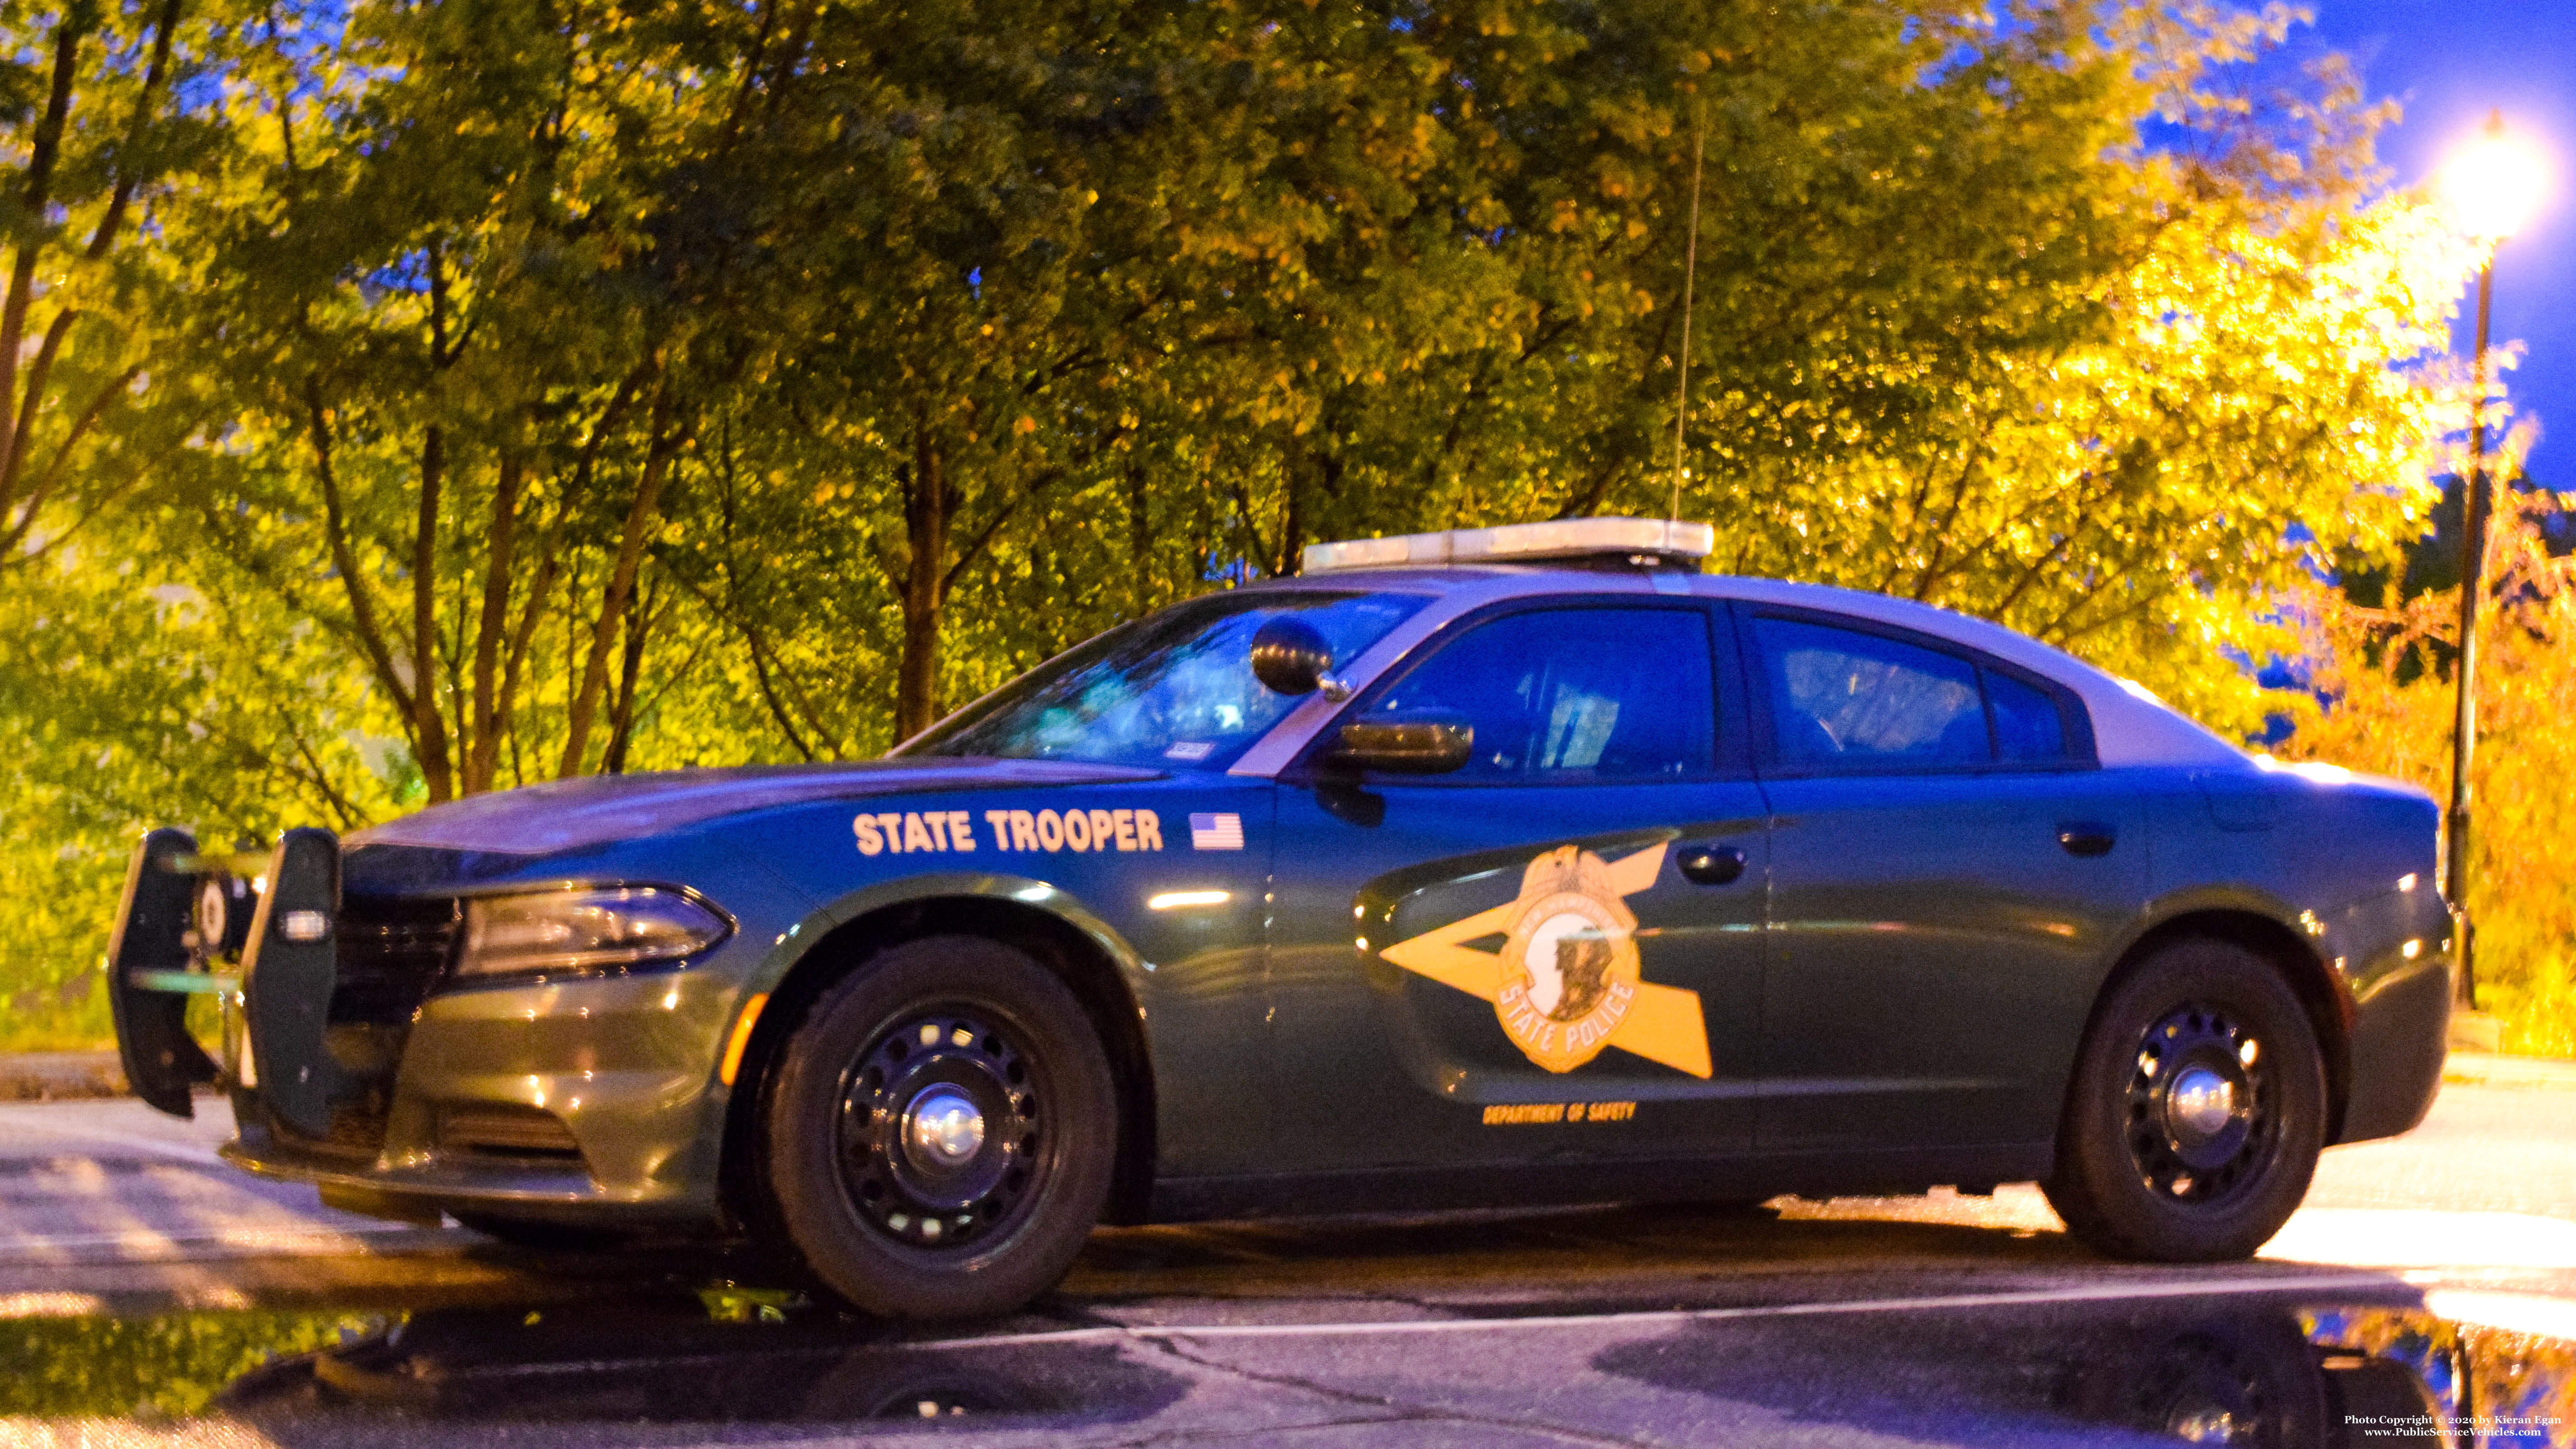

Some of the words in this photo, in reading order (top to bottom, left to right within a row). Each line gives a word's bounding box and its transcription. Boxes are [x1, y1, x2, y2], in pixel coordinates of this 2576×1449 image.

[853, 810, 976, 856] STATE
[985, 809, 1164, 852] TROOPER
[1499, 984, 1557, 1052] STATE
[1566, 982, 1634, 1052] POLICE
